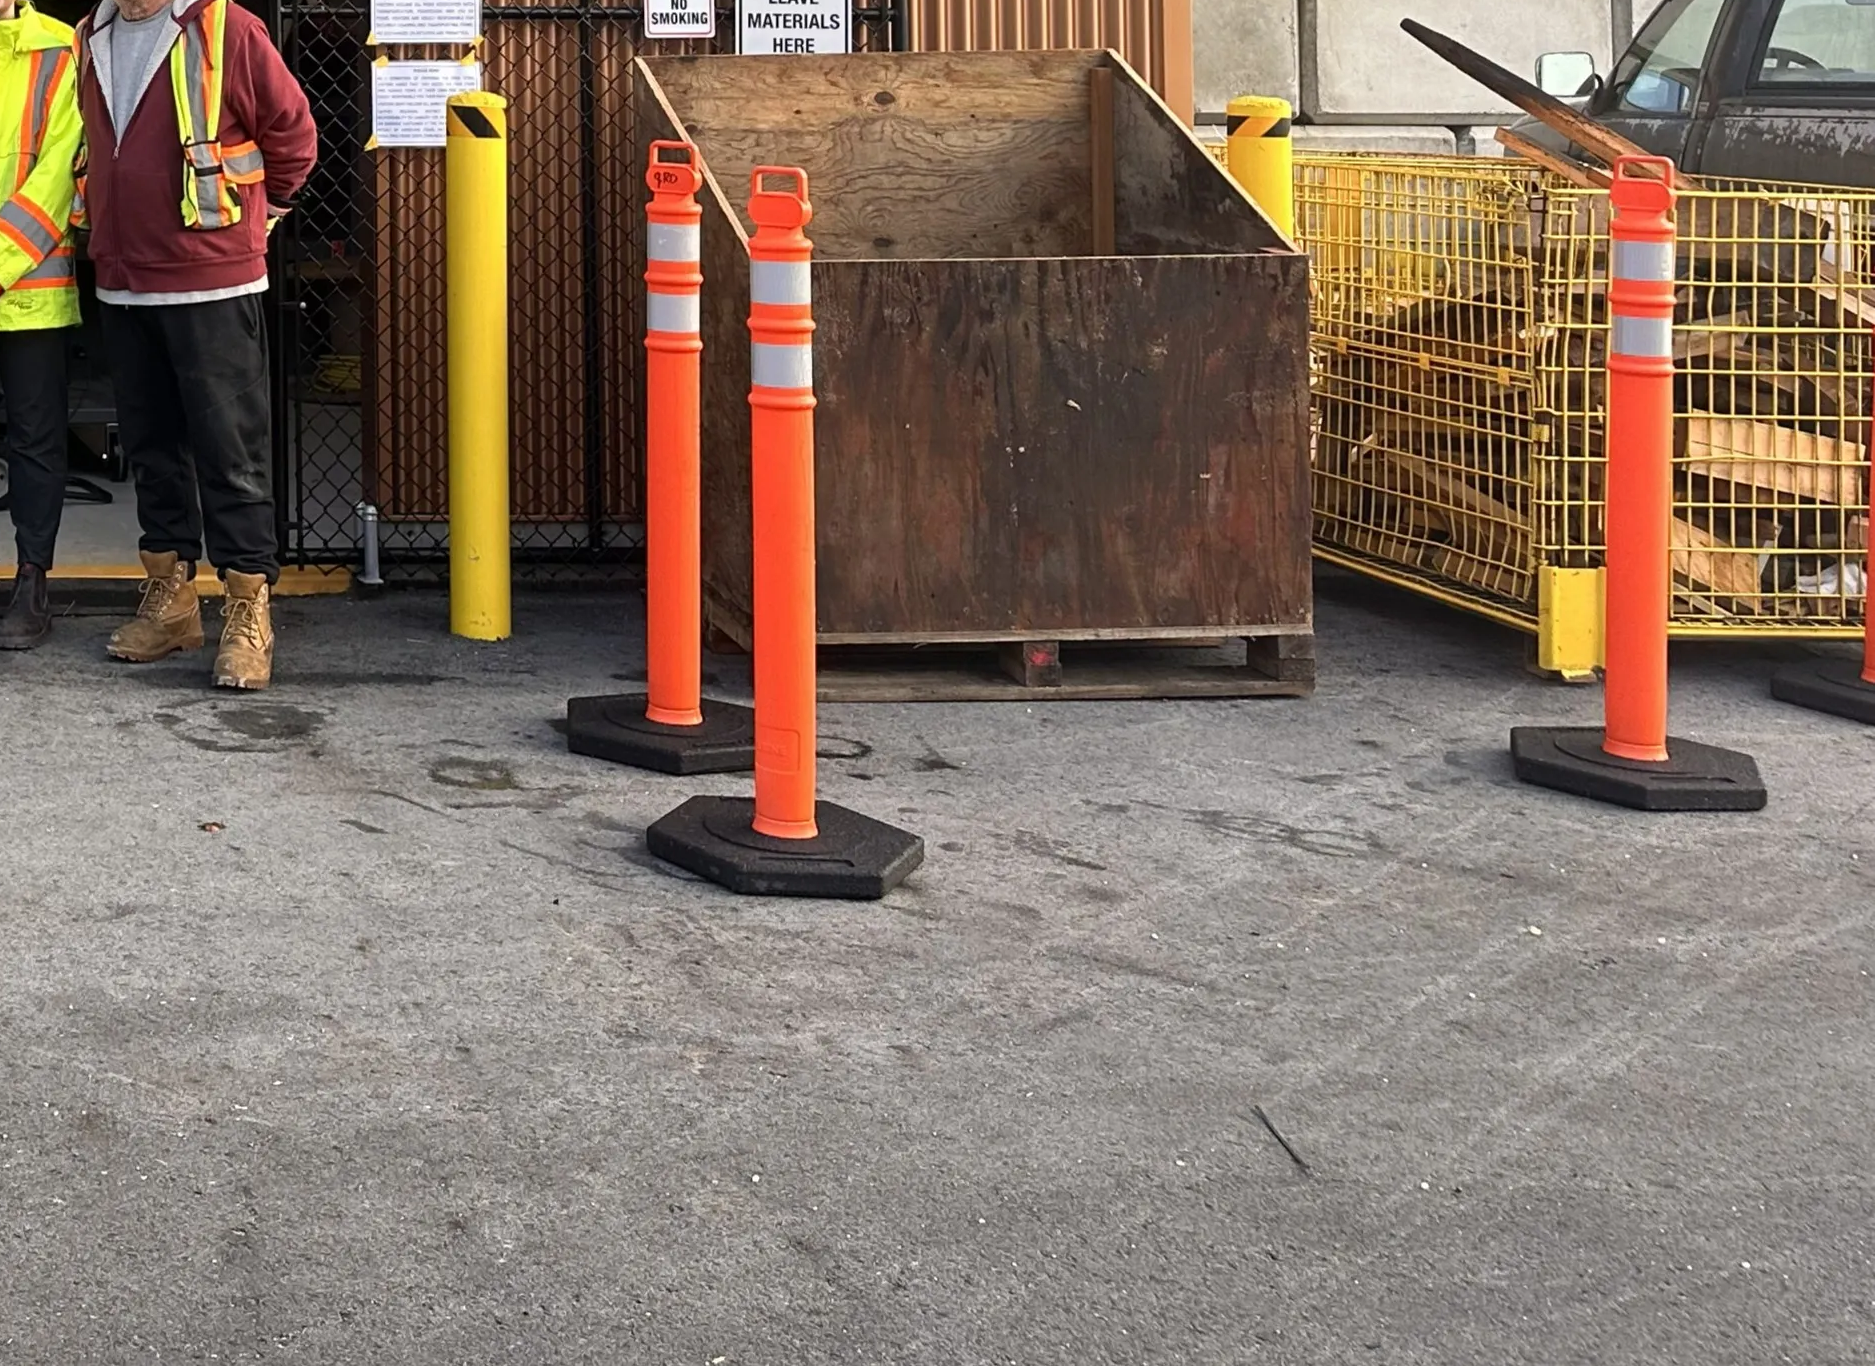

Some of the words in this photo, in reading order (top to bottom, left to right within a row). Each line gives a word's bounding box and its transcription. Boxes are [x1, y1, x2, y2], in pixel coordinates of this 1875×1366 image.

[651, 12, 708, 25] SMOKING
[747, 13, 840, 30] MATERIALS
[773, 38, 815, 53] HERE
